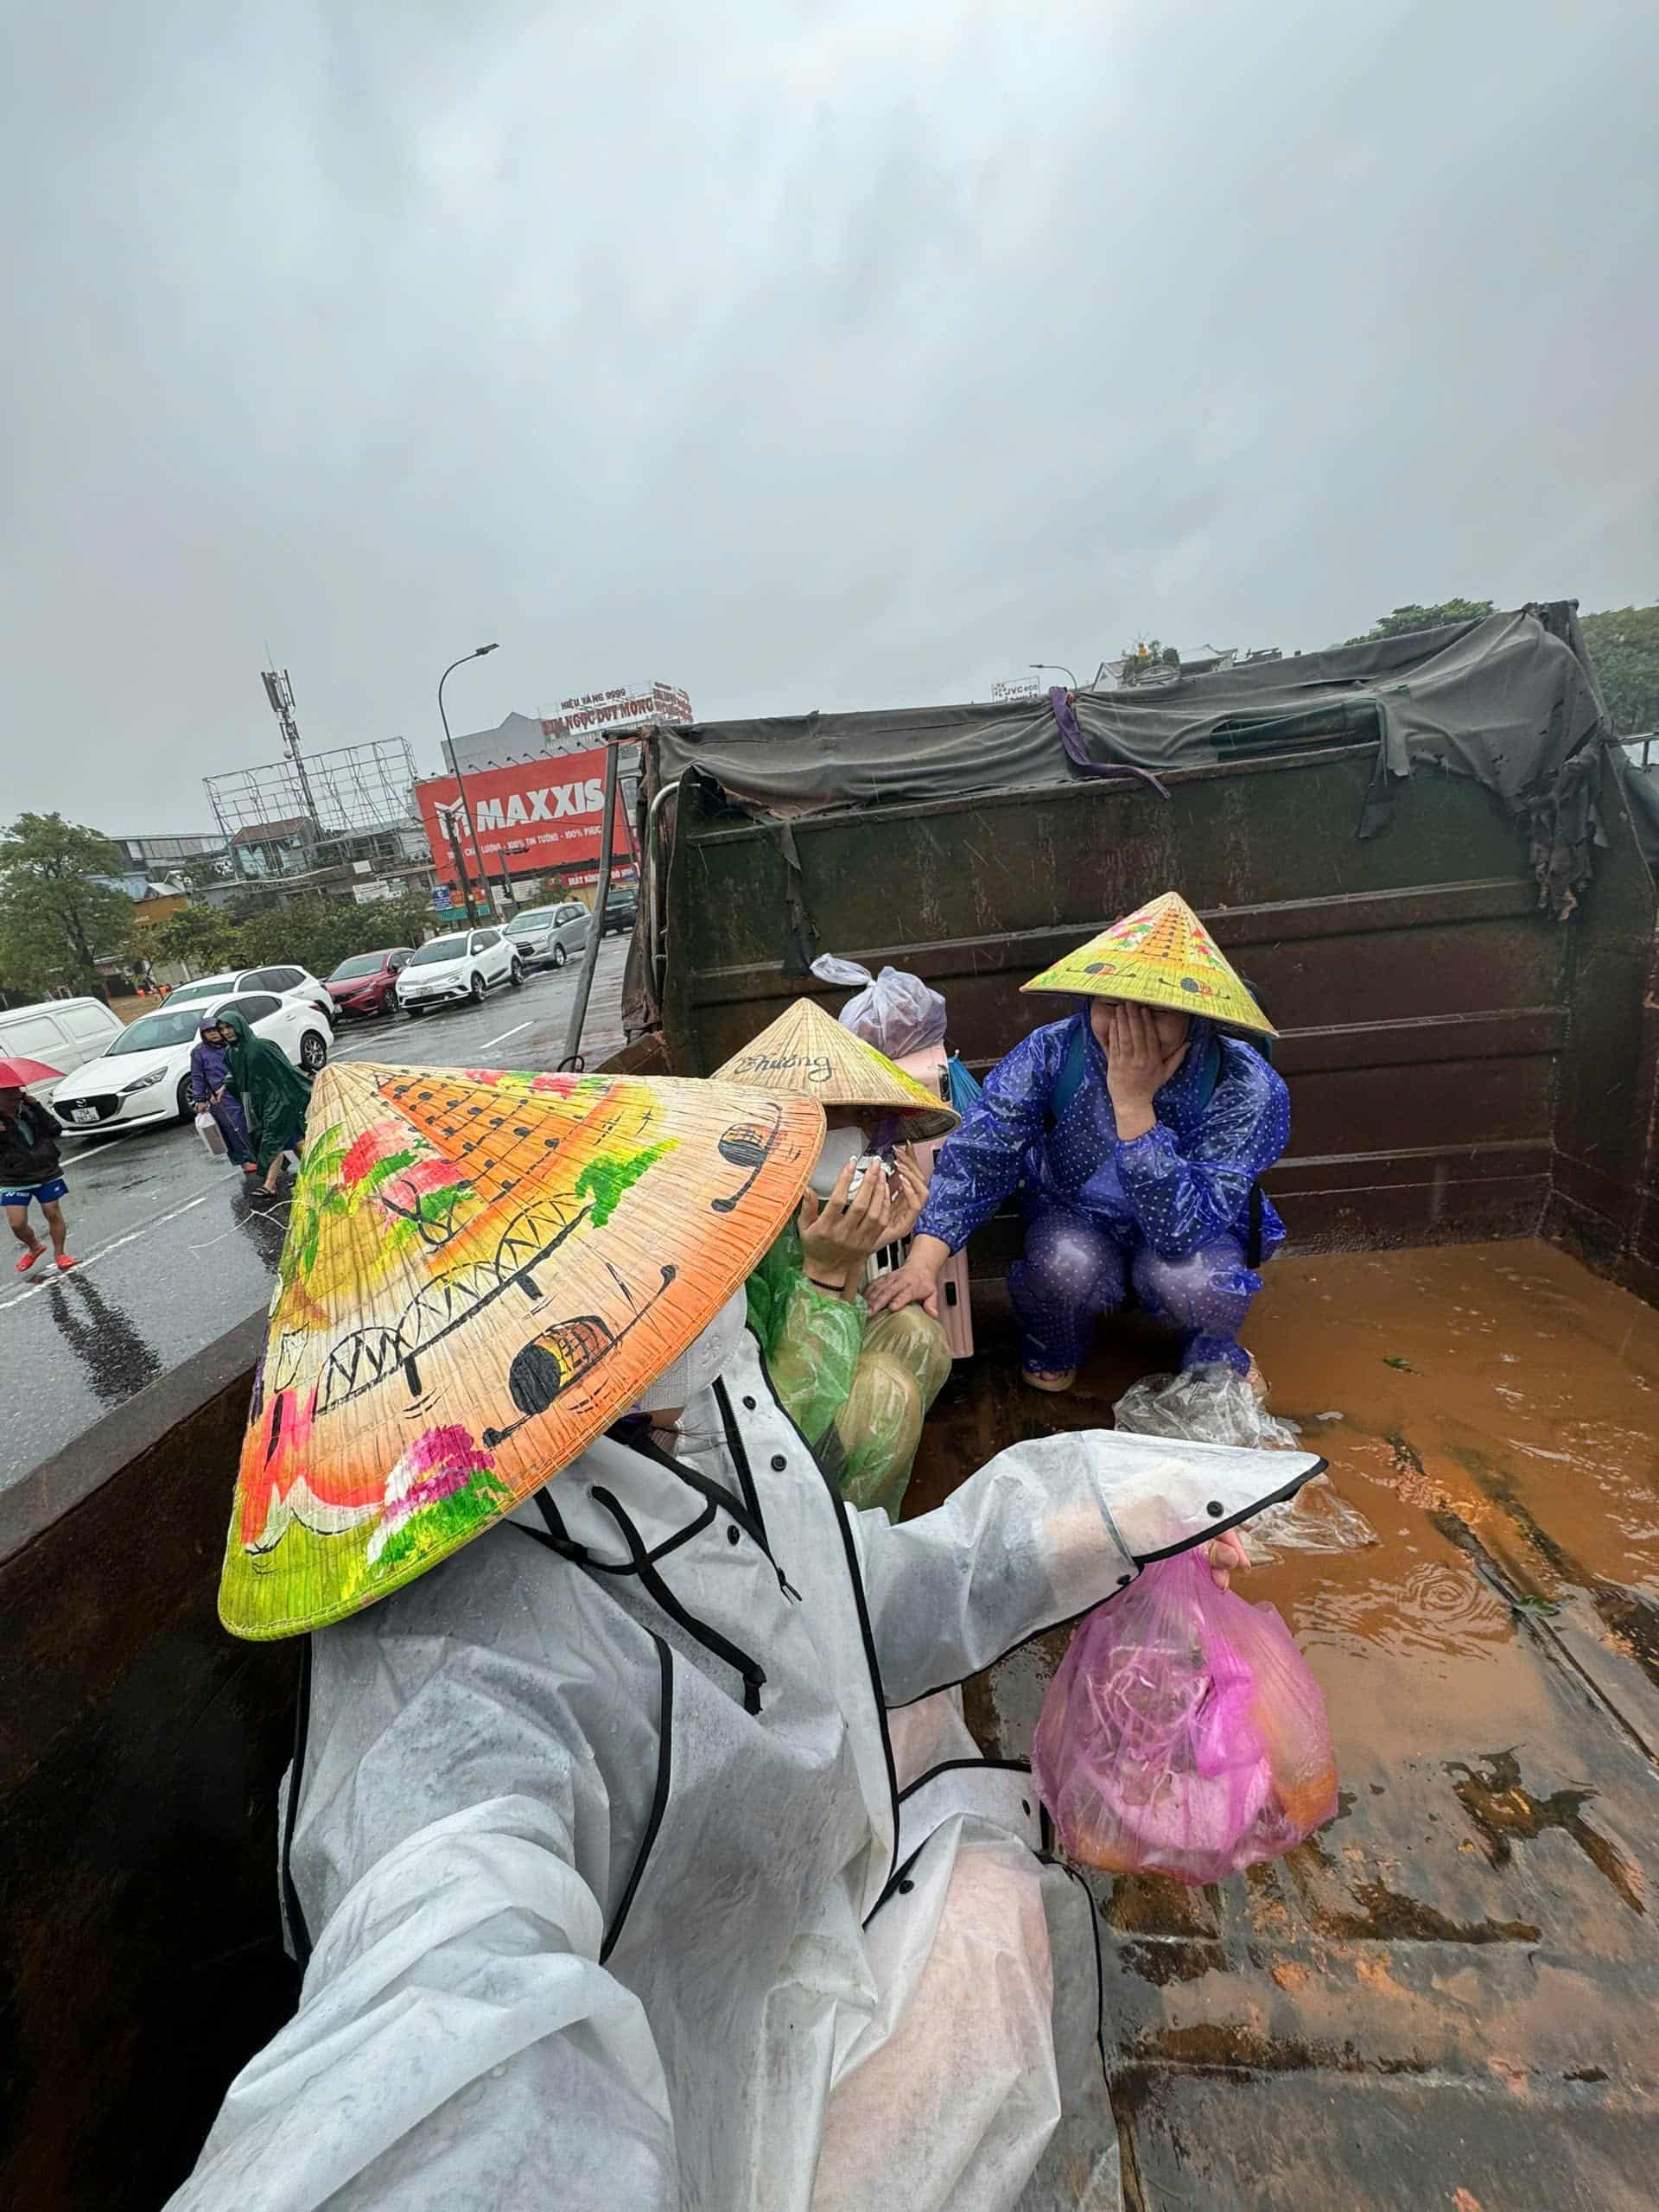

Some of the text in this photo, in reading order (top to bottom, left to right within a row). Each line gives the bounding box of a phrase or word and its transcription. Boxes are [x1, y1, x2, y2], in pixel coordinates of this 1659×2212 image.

[607, 689, 626, 700] 9999
[596, 704, 618, 724] DUY
[477, 779, 606, 832] MAXXIS
